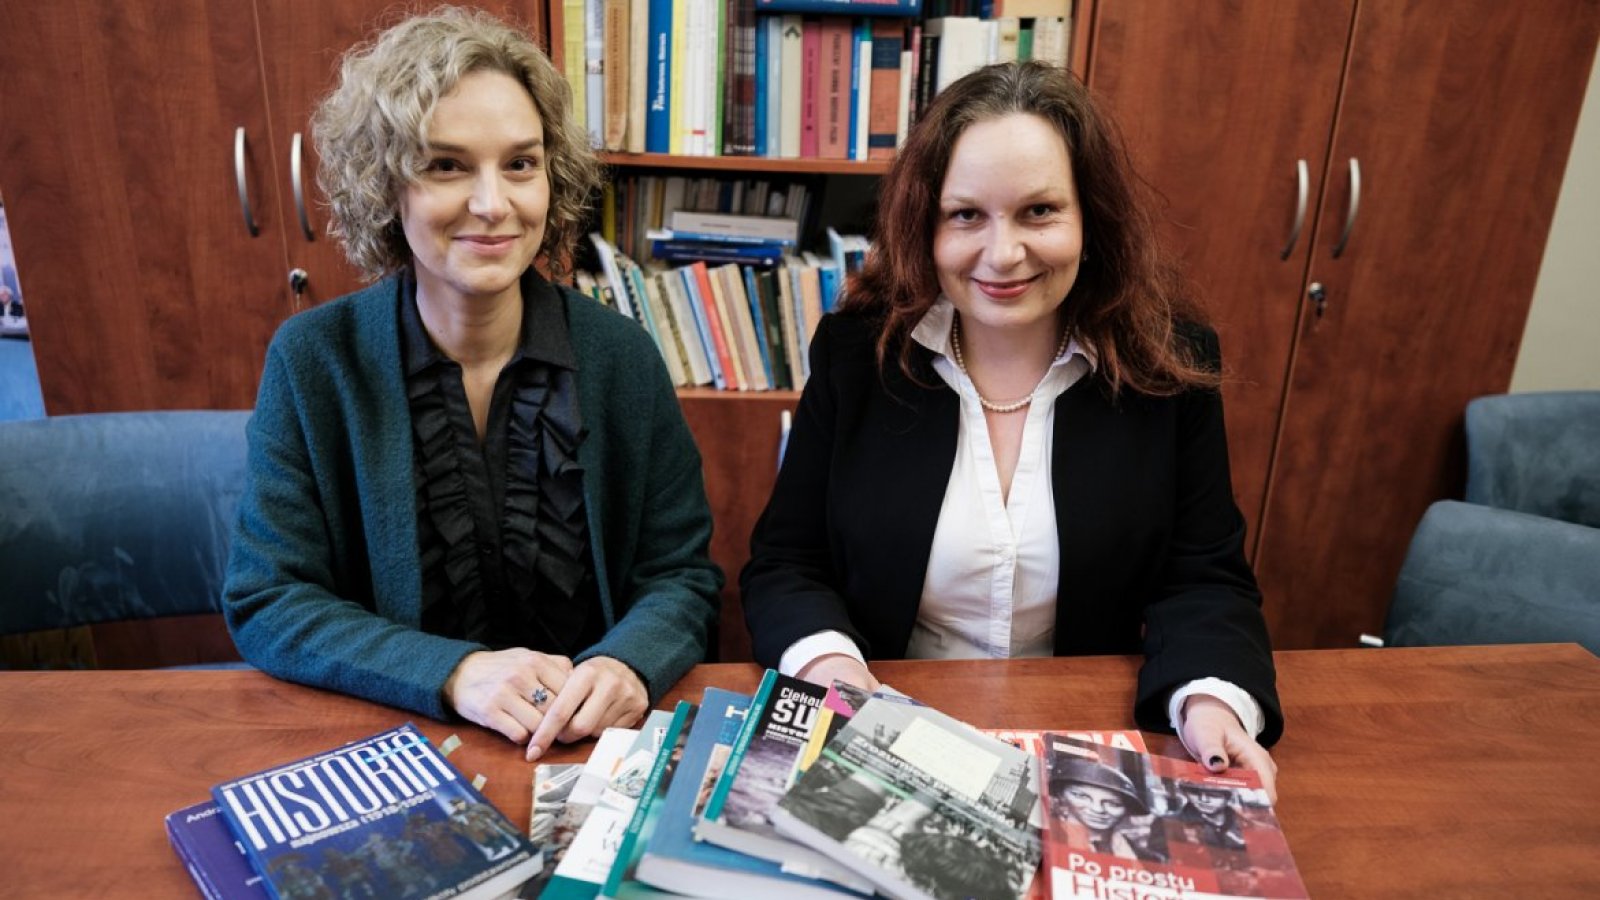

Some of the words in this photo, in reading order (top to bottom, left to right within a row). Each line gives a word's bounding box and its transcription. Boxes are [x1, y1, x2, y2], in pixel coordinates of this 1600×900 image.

[223, 731, 456, 850] HISTORIA
[1068, 852, 1101, 876] Po
[1109, 865, 1195, 892] prostu
